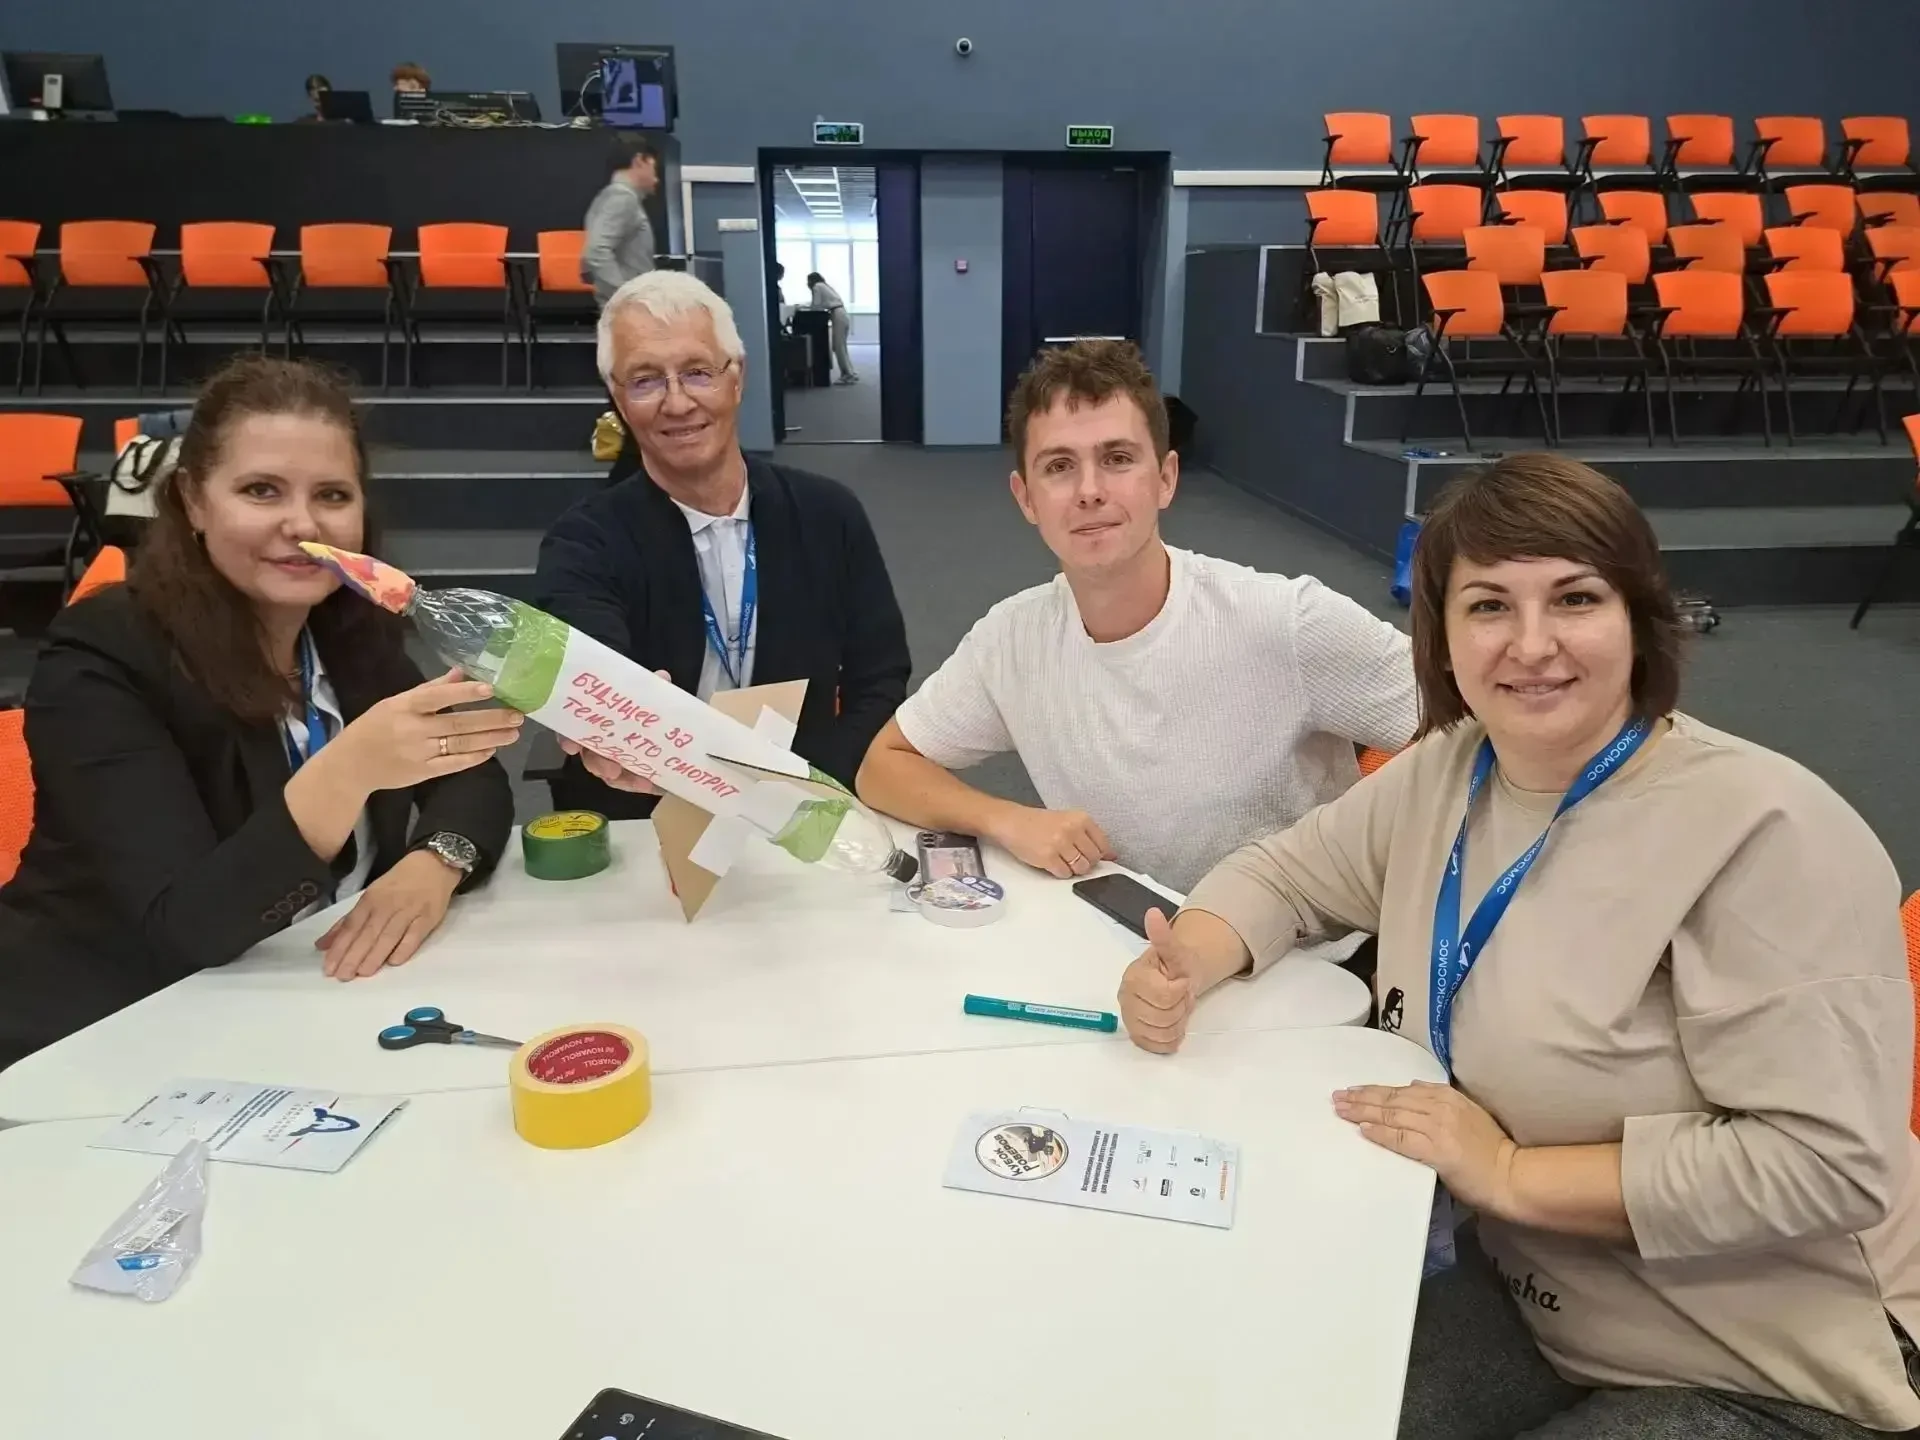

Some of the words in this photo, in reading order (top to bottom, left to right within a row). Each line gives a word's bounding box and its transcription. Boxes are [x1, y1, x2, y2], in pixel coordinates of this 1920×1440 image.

[1072, 129, 1108, 139] ВЫХОД
[1497, 832, 1546, 894] СКОСМОС
[542, 1039, 583, 1062] NOVAROLL
[561, 1046, 604, 1063] NOVAROLL
[993, 1134, 1040, 1171] РОВЕРОВ
[993, 1147, 1023, 1176] КУБОК
